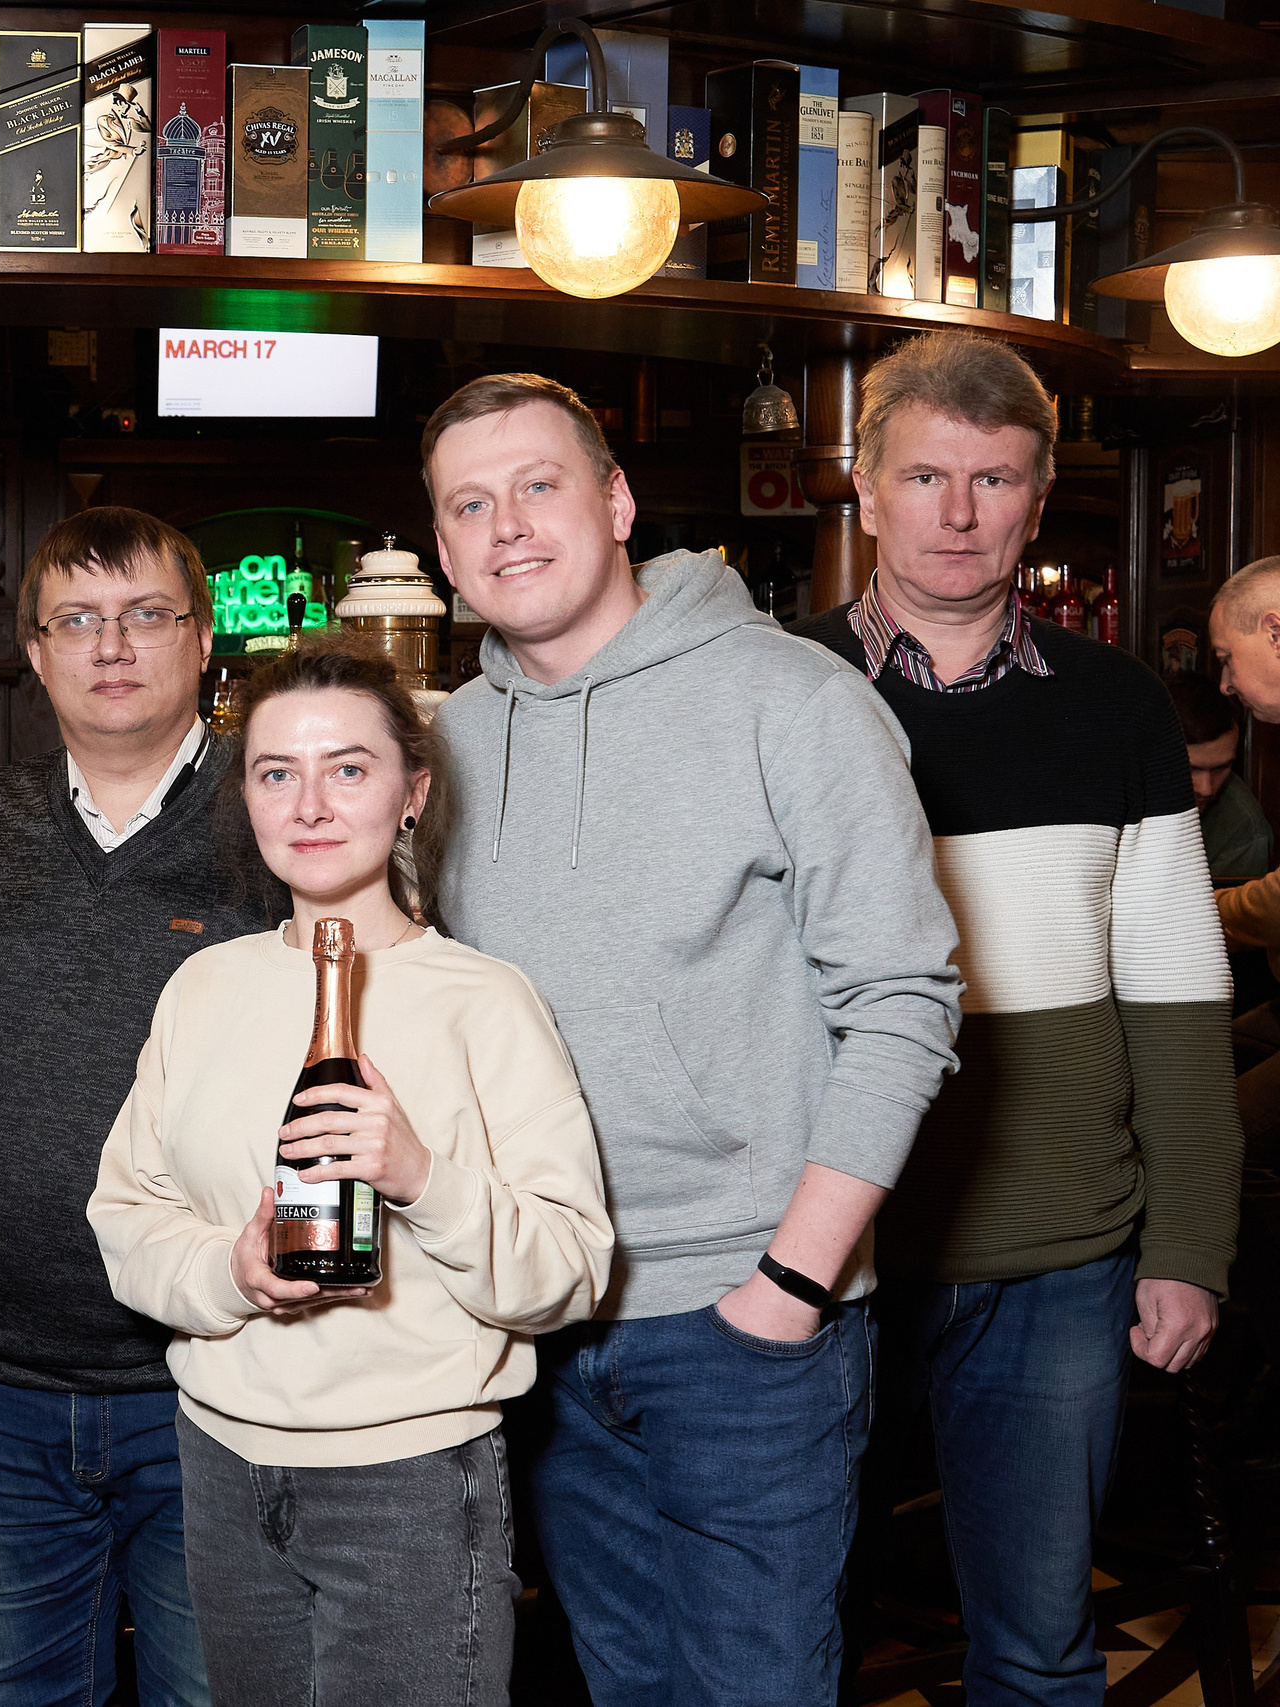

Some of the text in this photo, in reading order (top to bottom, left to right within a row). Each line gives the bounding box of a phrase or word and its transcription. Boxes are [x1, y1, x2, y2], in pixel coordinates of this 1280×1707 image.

[178, 47, 208, 55] MARTELL
[310, 48, 363, 63] JAMESON
[88, 55, 145, 84] BLACK LABEL
[5, 101, 73, 129] BLACK LABEL
[800, 106, 835, 119] GLENLIVET
[245, 121, 295, 134] CHIVAS REGAL
[260, 131, 282, 148] XV
[836, 158, 853, 166] THE
[950, 170, 979, 180] INCHMOAN
[30, 194, 46, 202] 12
[761, 119, 782, 273] RÉMY MARTIN
[165, 339, 276, 359] MARCH 17
[240, 555, 286, 580] on
[225, 602, 328, 632] rocs
[276, 1206, 320, 1219] STEFANO
